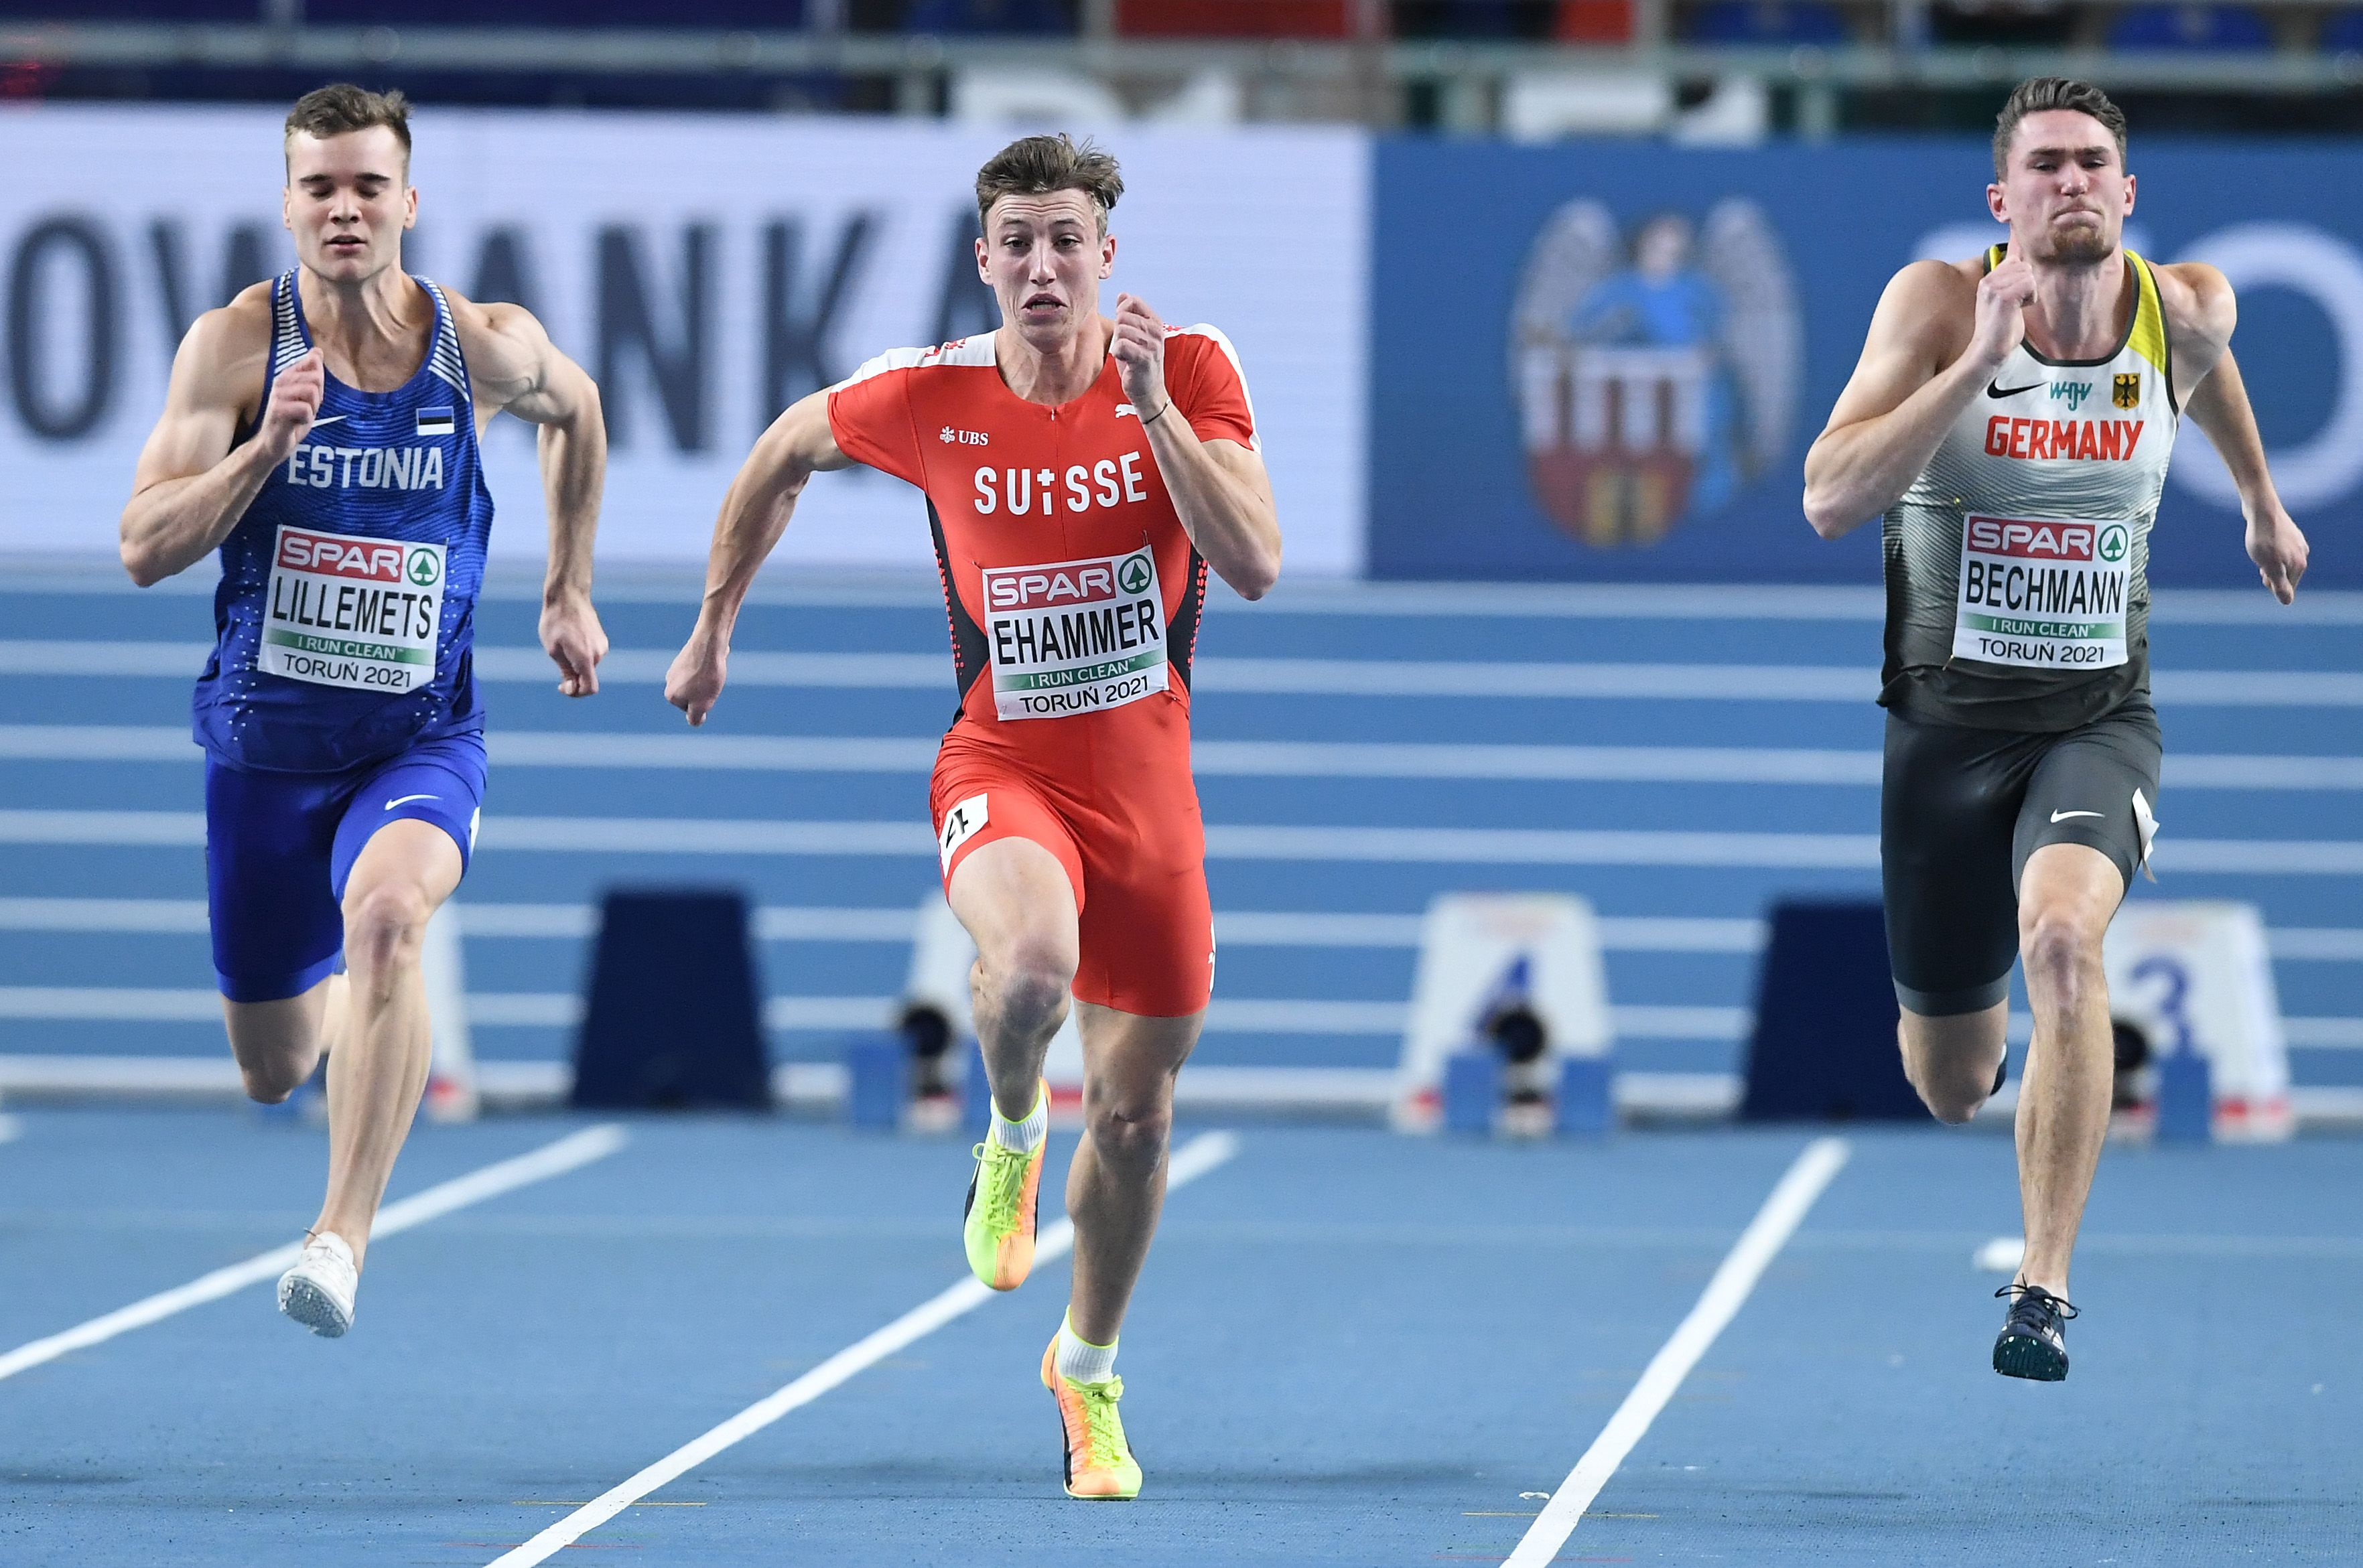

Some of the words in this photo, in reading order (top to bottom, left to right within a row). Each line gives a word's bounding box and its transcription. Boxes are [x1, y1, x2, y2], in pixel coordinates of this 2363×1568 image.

[958, 430, 989, 446] UBS
[1984, 415, 2144, 461] GERMANY
[287, 444, 444, 490] ESTONIA
[282, 536, 401, 577] SPAR
[1972, 522, 2091, 555] SPAR
[990, 567, 1111, 606] SPAR
[1966, 561, 2124, 615] BECHMANN
[273, 576, 433, 639] LILLEMETS
[1993, 618, 1997, 630] I
[2001, 620, 2035, 634] RUN
[298, 635, 303, 646] I
[306, 637, 340, 654] RUN
[994, 598, 1158, 665] EHAMMER
[1978, 637, 2055, 662] TORUŃ
[2061, 645, 2104, 663] 2021
[283, 653, 359, 681] TORUŃ
[364, 666, 411, 688] 2021
[1029, 675, 1034, 688] I
[1039, 670, 1074, 687] RUN
[1020, 686, 1100, 713] TORUŃ
[1105, 675, 1149, 703] 2021
[946, 808, 969, 849] 4
